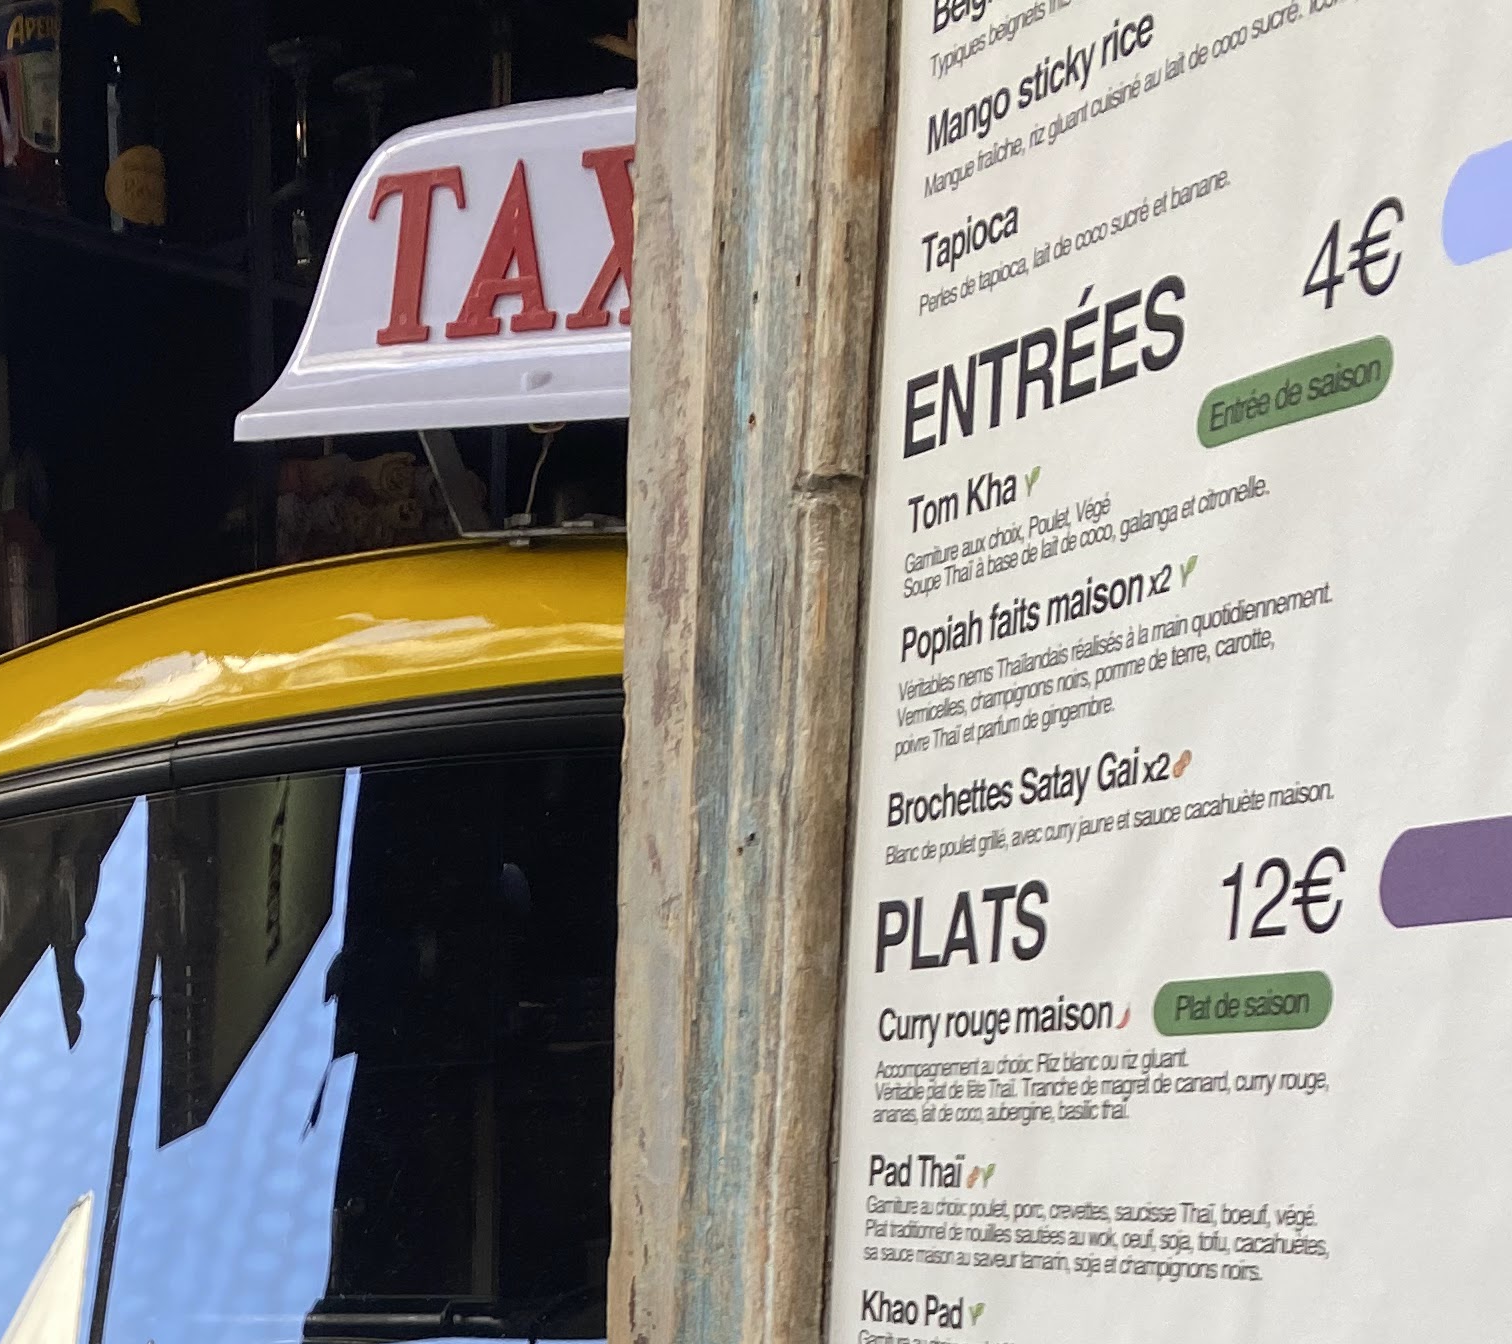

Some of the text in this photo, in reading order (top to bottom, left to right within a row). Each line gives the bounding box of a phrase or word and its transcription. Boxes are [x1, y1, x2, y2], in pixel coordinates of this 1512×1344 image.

[924, 160, 974, 198] Mangue
[1029, 123, 1045, 148] riz
[1048, 100, 1088, 144] gluant
[1090, 72, 1140, 117] cuisiné
[1143, 67, 1161, 92] au
[1164, 51, 1185, 81] lait
[1187, 43, 1208, 69] de
[1211, 25, 1247, 58] coco
[926, 13, 1155, 155] Mango sticky rice
[368, 143, 635, 346] TAX
[918, 170, 1230, 316] Perles de tapioca, lait de coco sucré et banane.
[921, 205, 1018, 273] Tapioca
[1301, 195, 1405, 310] 4€
[903, 274, 1186, 459] ENTRÉES
[1210, 357, 1382, 431] Entrée de saison
[907, 471, 1016, 533] Tom Kha
[900, 562, 1172, 664] Popiah faits maison x2
[886, 745, 1170, 827] Brochettes Satay Gai x2
[873, 880, 1049, 973] PLATS
[1222, 846, 1347, 940] 12€
[877, 994, 1113, 1048] Curry rouge maison
[1174, 986, 1310, 1022] Plat de saison
[868, 1153, 965, 1188] Pad Thaï
[860, 1289, 963, 1329] Khao Pad
